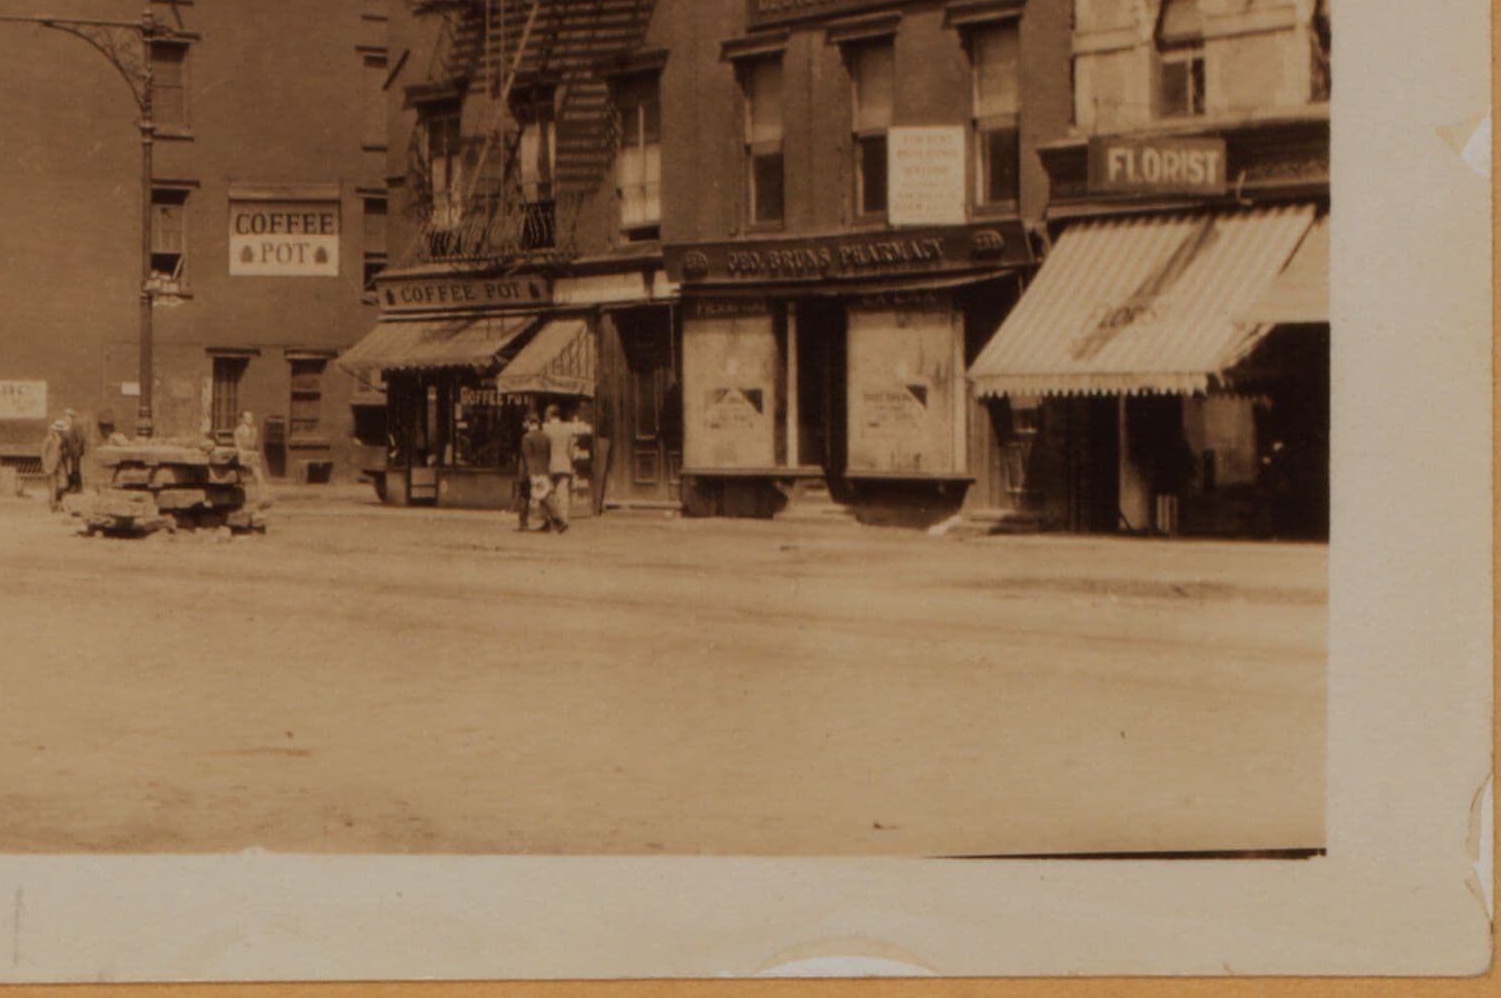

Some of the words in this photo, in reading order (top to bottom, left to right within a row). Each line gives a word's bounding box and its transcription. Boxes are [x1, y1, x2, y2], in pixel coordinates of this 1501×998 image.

[1106, 146, 1220, 186] FLORIST
[234, 212, 335, 235] COFFEE
[260, 241, 309, 267] POT
[839, 237, 945, 268] PHARMACY
[400, 281, 476, 304] COFFEE
[484, 281, 523, 299] POT
